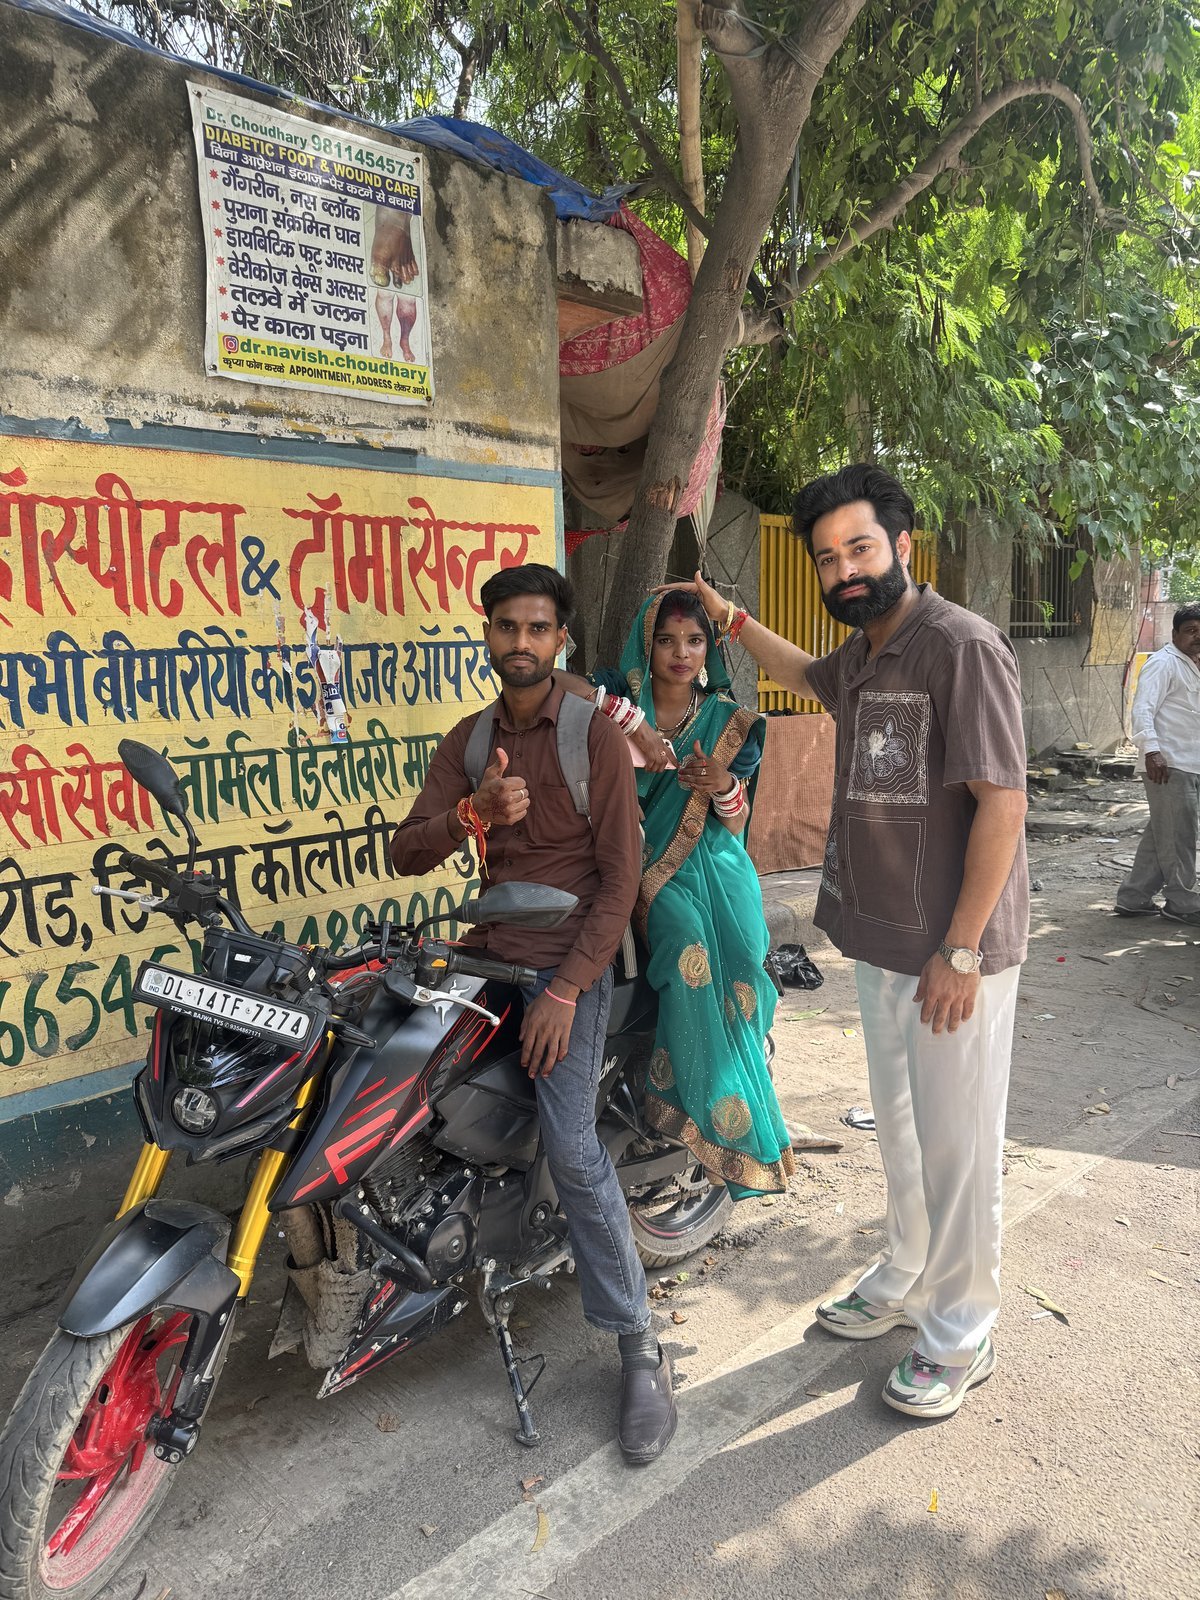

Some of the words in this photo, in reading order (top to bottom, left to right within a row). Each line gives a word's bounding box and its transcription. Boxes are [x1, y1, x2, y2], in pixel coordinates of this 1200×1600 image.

[204, 125, 275, 157] DIABETIC
[279, 147, 315, 169] FOOT
[320, 159, 330, 172] &
[333, 163, 382, 188] WOUND
[385, 180, 418, 199] CARE
[206, 106, 226, 124] Dr.
[231, 113, 307, 148] Choudhary
[311, 134, 415, 180] 9811454573
[210, 141, 238, 161] बिना
[346, 183, 374, 200] कटने
[376, 190, 385, 203] से
[223, 198, 268, 224] पुराना
[271, 206, 331, 240] संक्रमित
[334, 226, 361, 247] घाव
[290, 188, 317, 212] नस
[321, 196, 361, 222] ब्लॉक
[225, 225, 295, 258] डायबिटिक
[298, 243, 322, 273] फूट
[325, 250, 364, 274] अल्सर
[227, 250, 287, 287] वेरीकोज
[291, 265, 322, 294] वेन्स
[325, 278, 367, 303] अल्सर
[230, 283, 283, 309] तलवे
[288, 291, 309, 313] में
[313, 299, 367, 326] जलन
[231, 304, 260, 331] पैर
[264, 315, 315, 341] काला
[240, 338, 427, 385] dr.navish.choudhary
[246, 360, 263, 370] फोन
[264, 361, 285, 374] करके
[289, 364, 354, 385] APPOINTMENT,
[356, 375, 393, 390] ADDRESS
[394, 382, 411, 394] लेकर
[241, 535, 281, 601] &
[92, 625, 251, 723] बीमारियों
[250, 805, 400, 904] कॉलोनी
[163, 976, 183, 1000] DL
[196, 987, 243, 1016] 14TF
[251, 1003, 302, 1036] 7274
[170, 1005, 182, 1013] TVS
[193, 1012, 212, 1022] BAJWA
[213, 1019, 224, 1027] TVS
